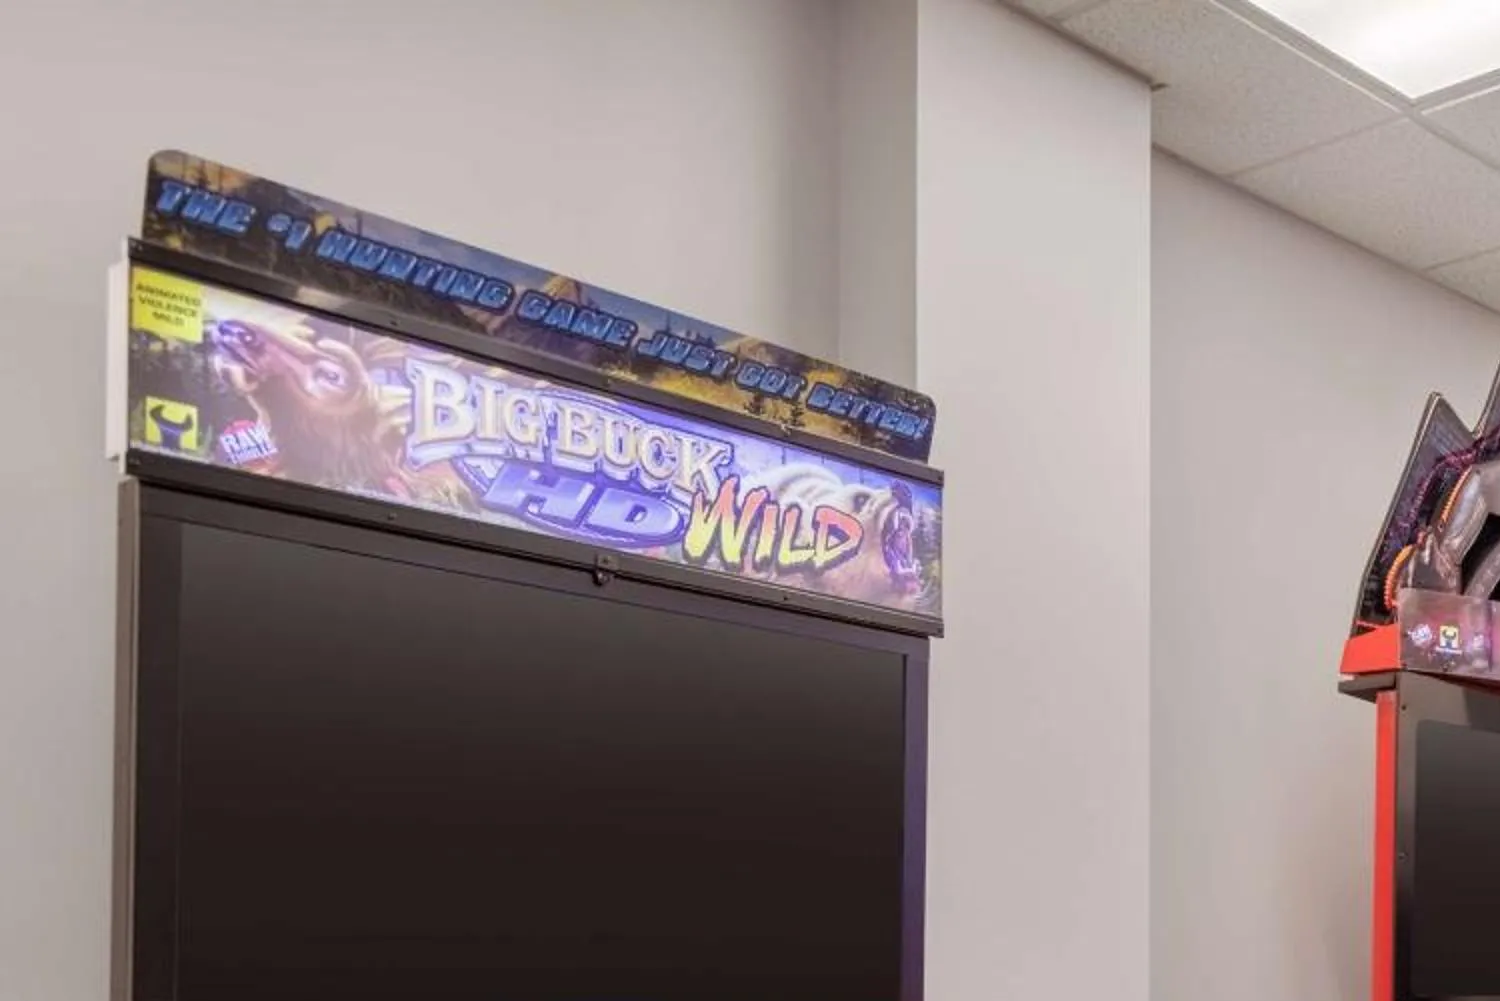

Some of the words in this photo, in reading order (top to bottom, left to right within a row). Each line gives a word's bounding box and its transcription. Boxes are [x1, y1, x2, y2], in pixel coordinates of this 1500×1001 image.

[158, 180, 256, 233] THE
[266, 214, 312, 250] #1
[317, 229, 513, 311] HUNTING
[518, 293, 637, 345] GAME
[637, 332, 736, 378] JUST
[738, 363, 806, 398] GOT
[808, 382, 930, 438] BETTER!
[484, 463, 685, 541] HD
[684, 477, 864, 572] WILD
